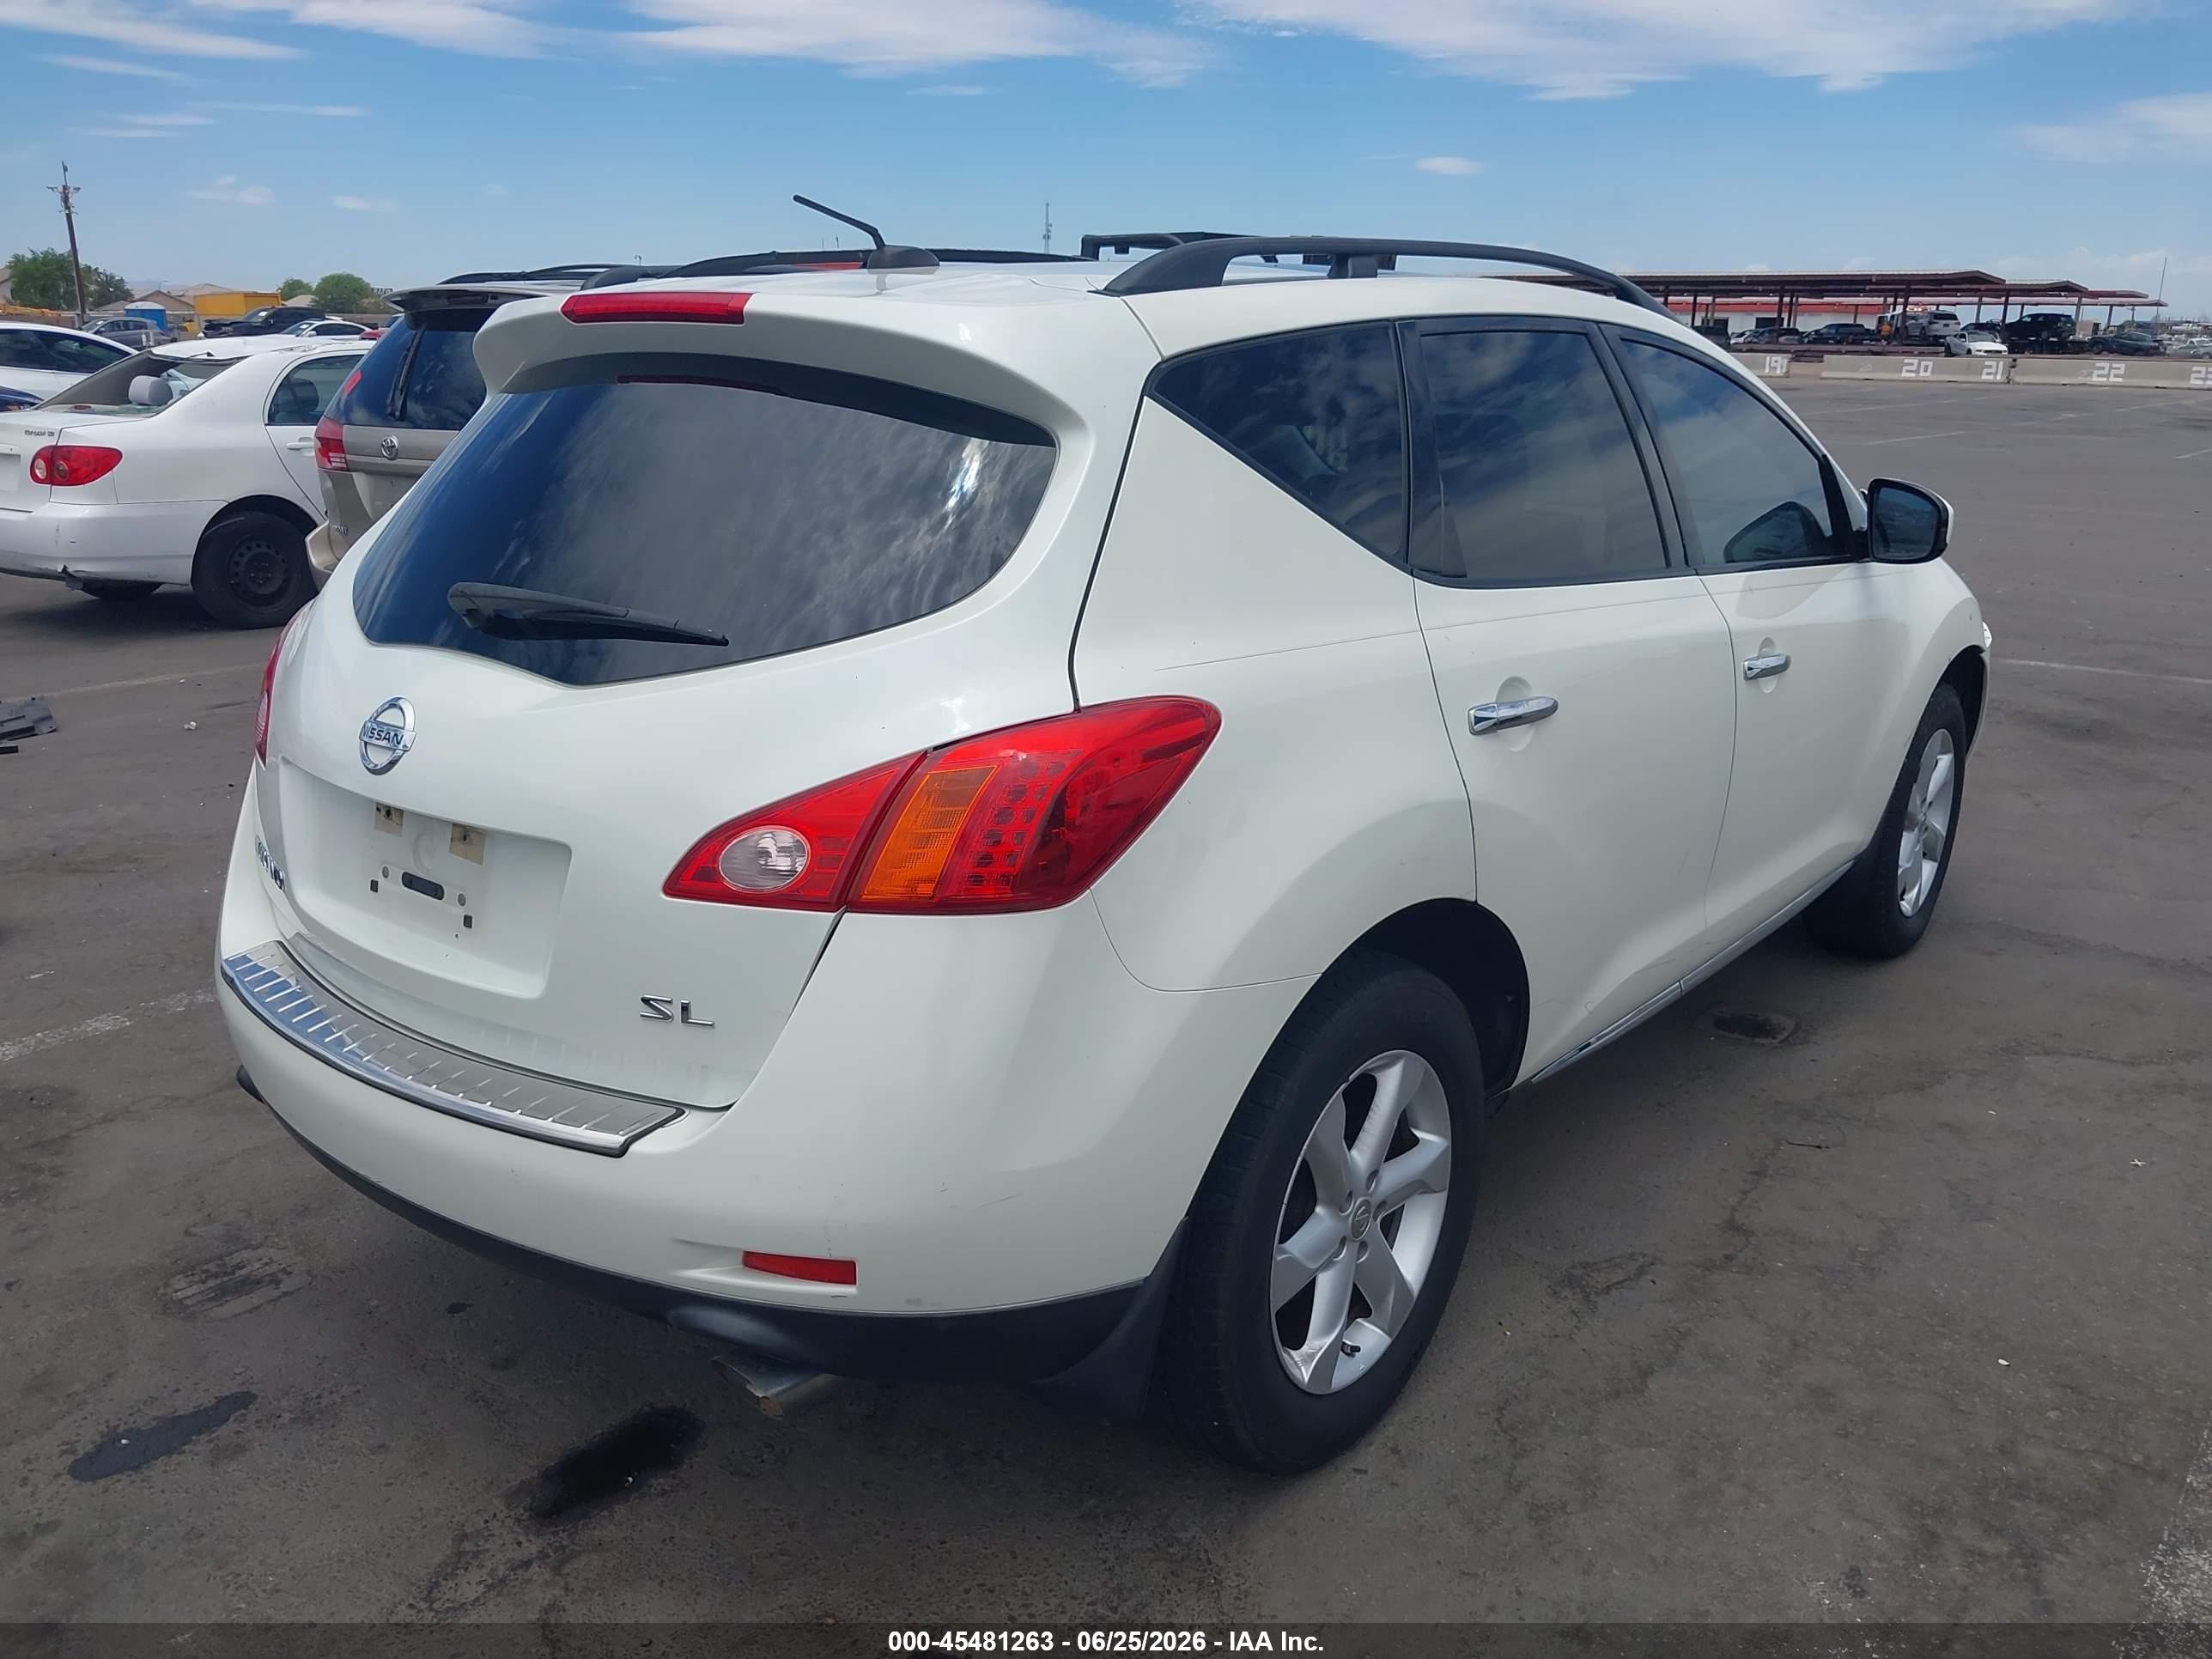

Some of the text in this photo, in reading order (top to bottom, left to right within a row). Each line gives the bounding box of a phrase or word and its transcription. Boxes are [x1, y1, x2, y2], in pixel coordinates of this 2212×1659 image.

[1901, 359, 1934, 377] 20
[1981, 361, 2004, 380] 21
[2092, 362, 2125, 383] 22
[362, 723, 404, 745] NISSAN
[640, 994, 714, 1028] SL
